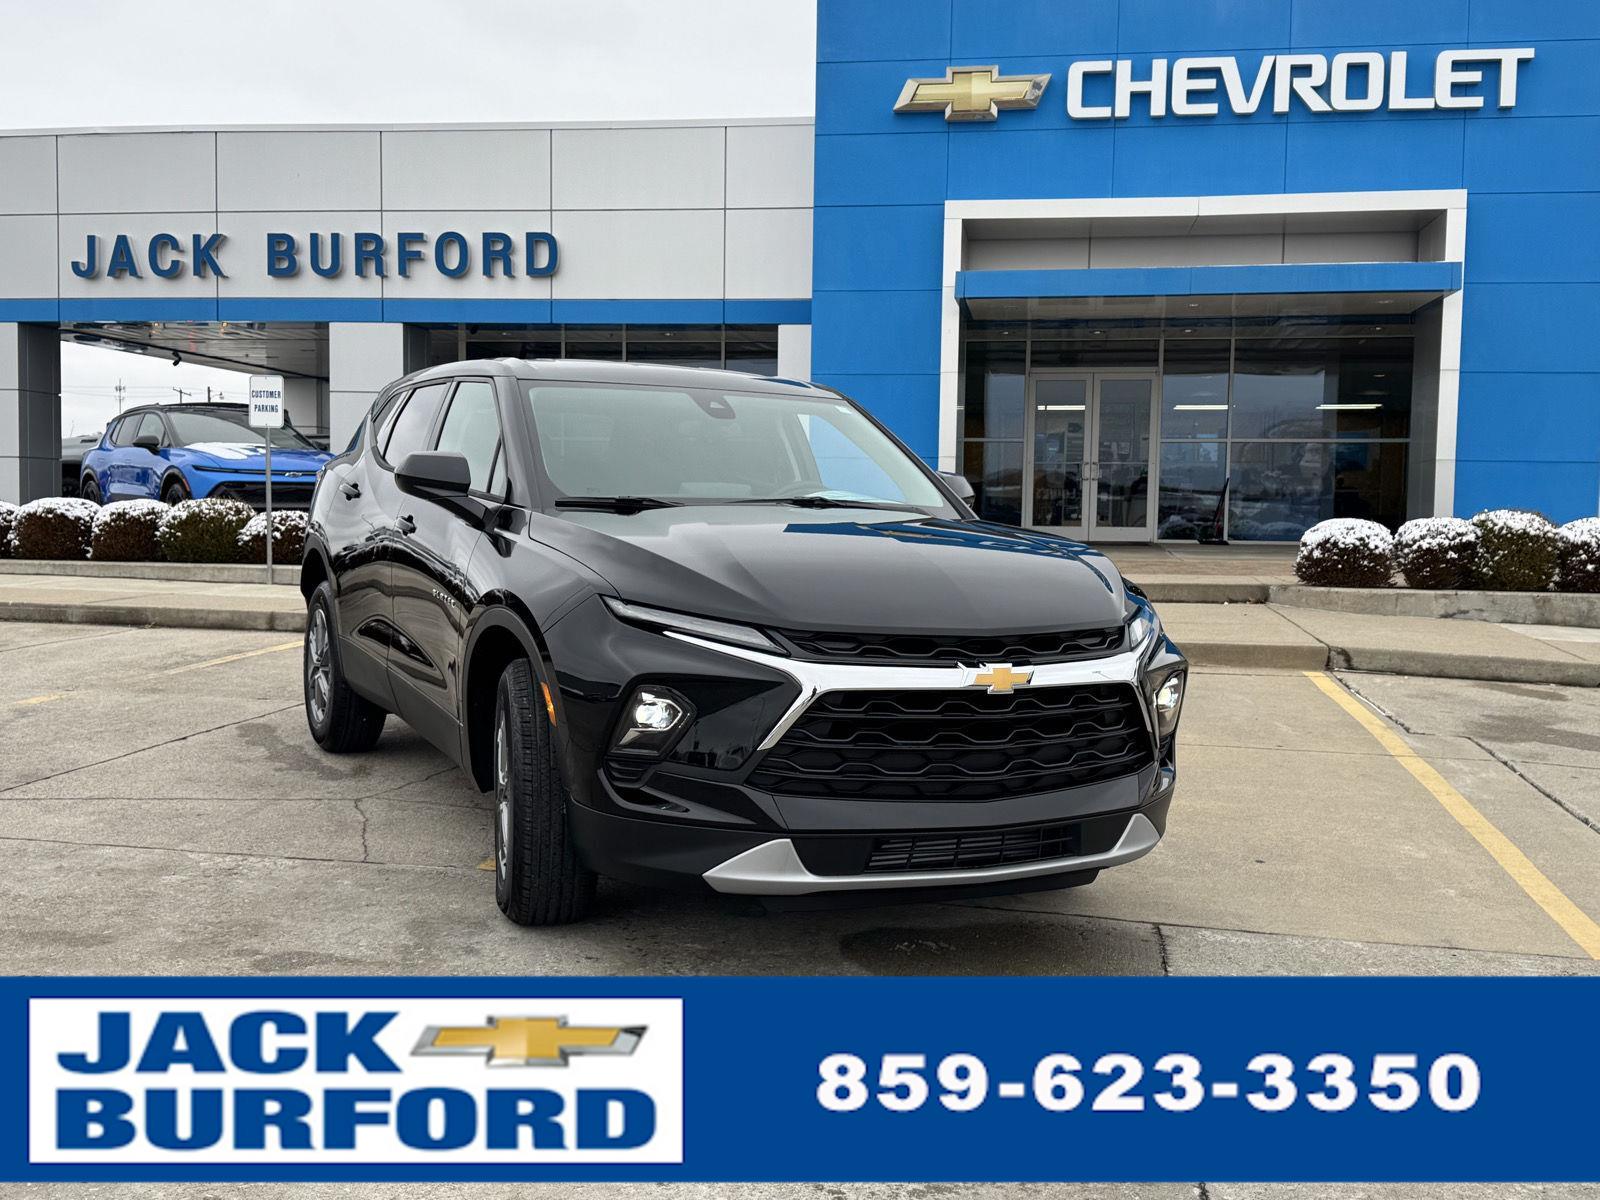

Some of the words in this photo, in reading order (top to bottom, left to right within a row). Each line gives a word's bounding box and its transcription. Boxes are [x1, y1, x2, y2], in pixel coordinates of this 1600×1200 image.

[1066, 47, 1535, 121] CHEVROLET
[71, 233, 226, 279] JACK
[266, 231, 559, 278] BURFORD
[251, 390, 281, 399] CUSTOMER
[254, 404, 279, 413] PARKING
